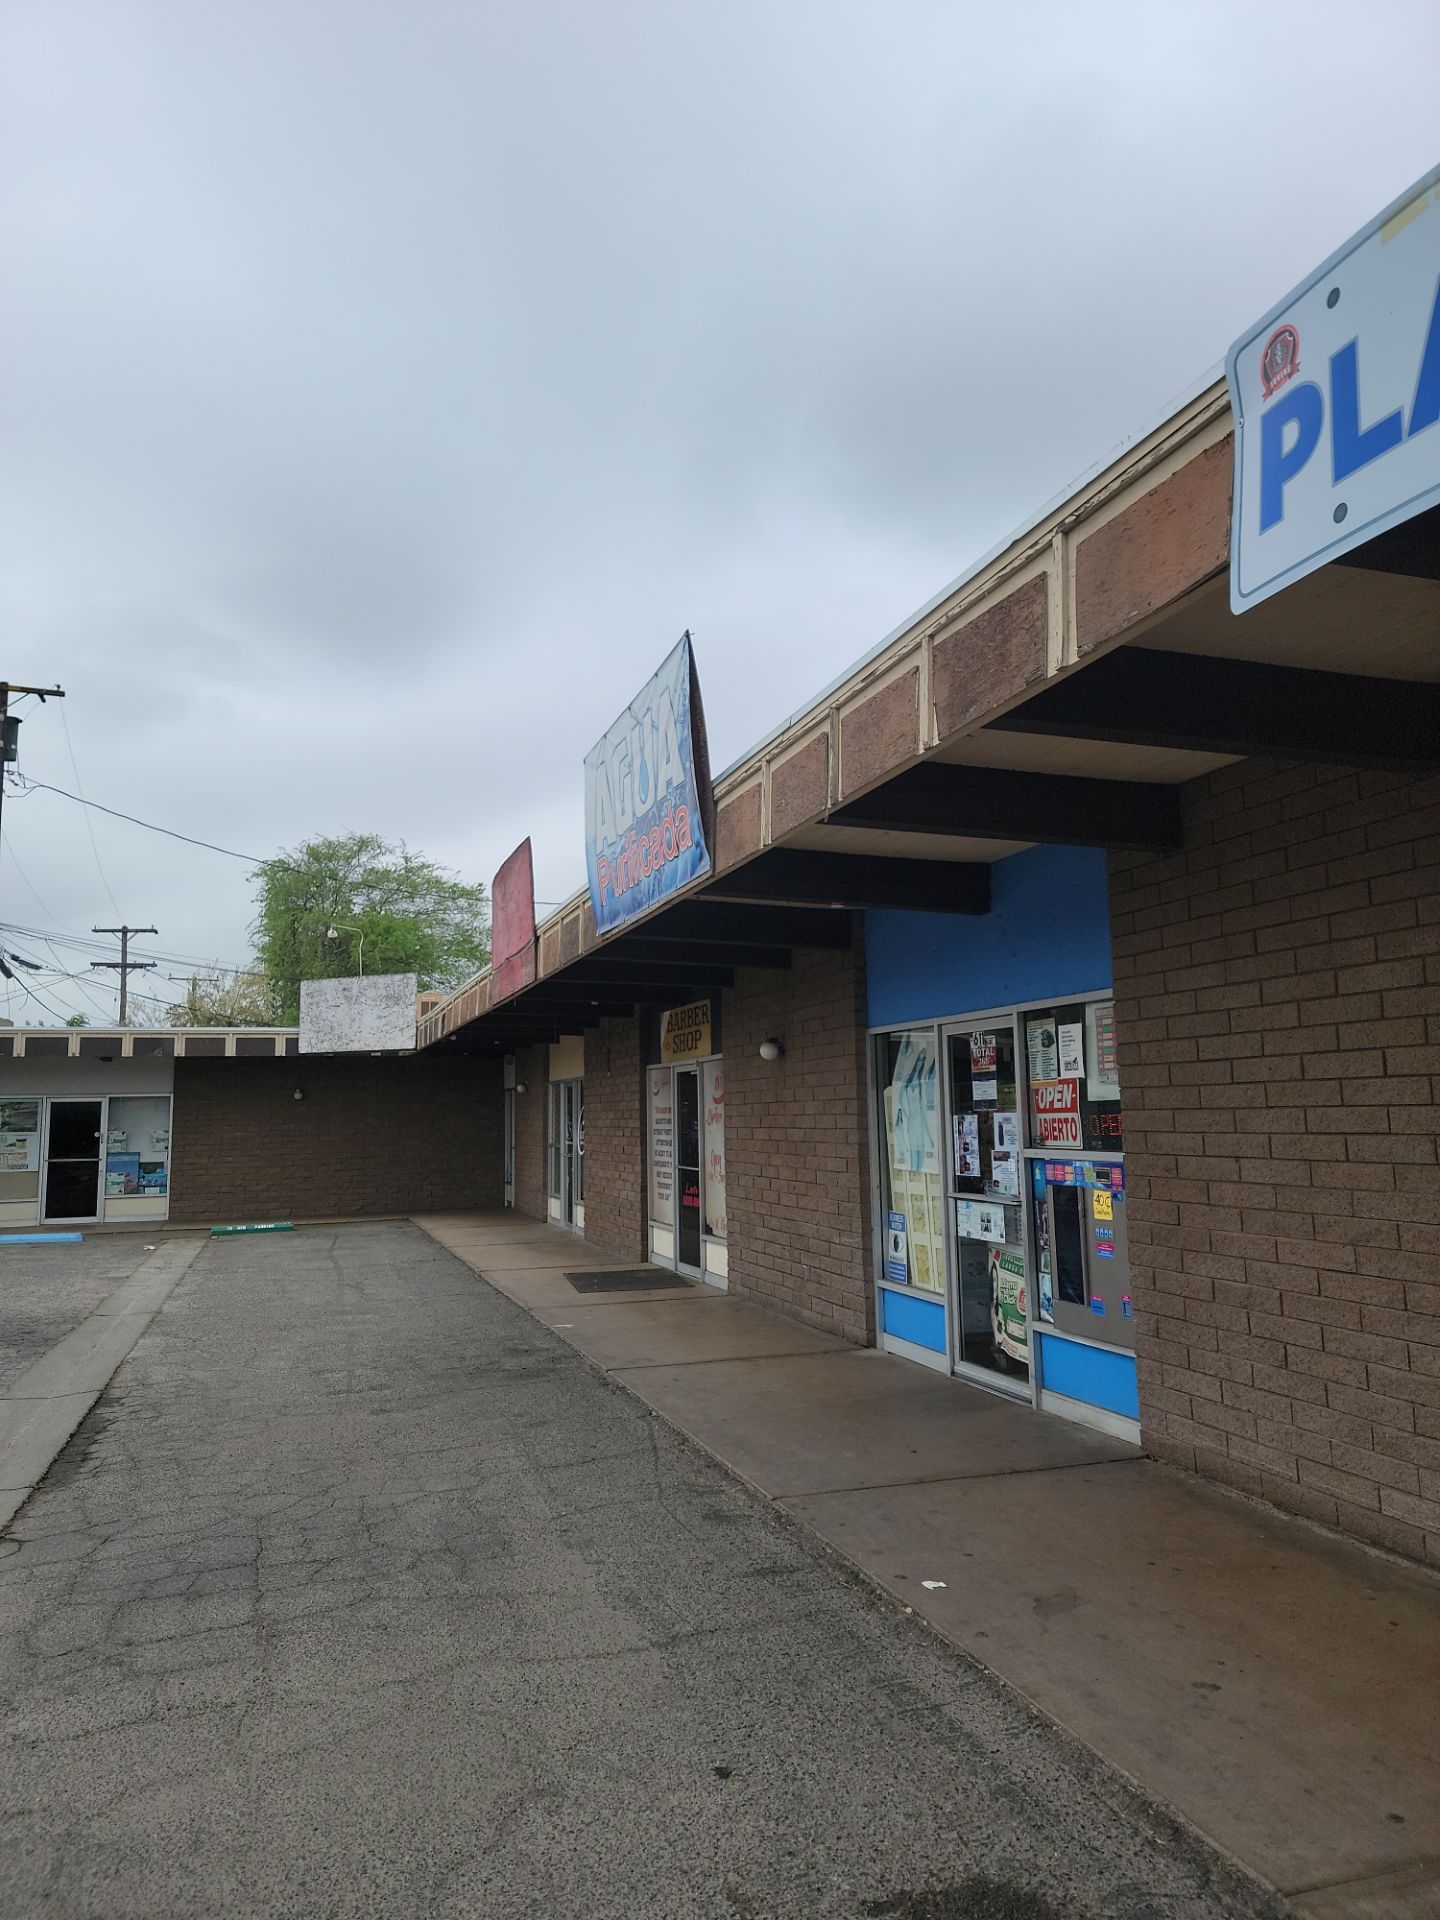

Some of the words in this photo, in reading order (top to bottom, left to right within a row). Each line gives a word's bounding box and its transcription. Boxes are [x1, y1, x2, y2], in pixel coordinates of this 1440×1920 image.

[596, 686, 687, 854] AGUA
[596, 803, 693, 906] Purificada
[667, 1003, 710, 1033] BARBER
[672, 1030, 702, 1054] SHOP
[972, 1047, 996, 1058] TOTAL
[1038, 1083, 1073, 1110] OPEN
